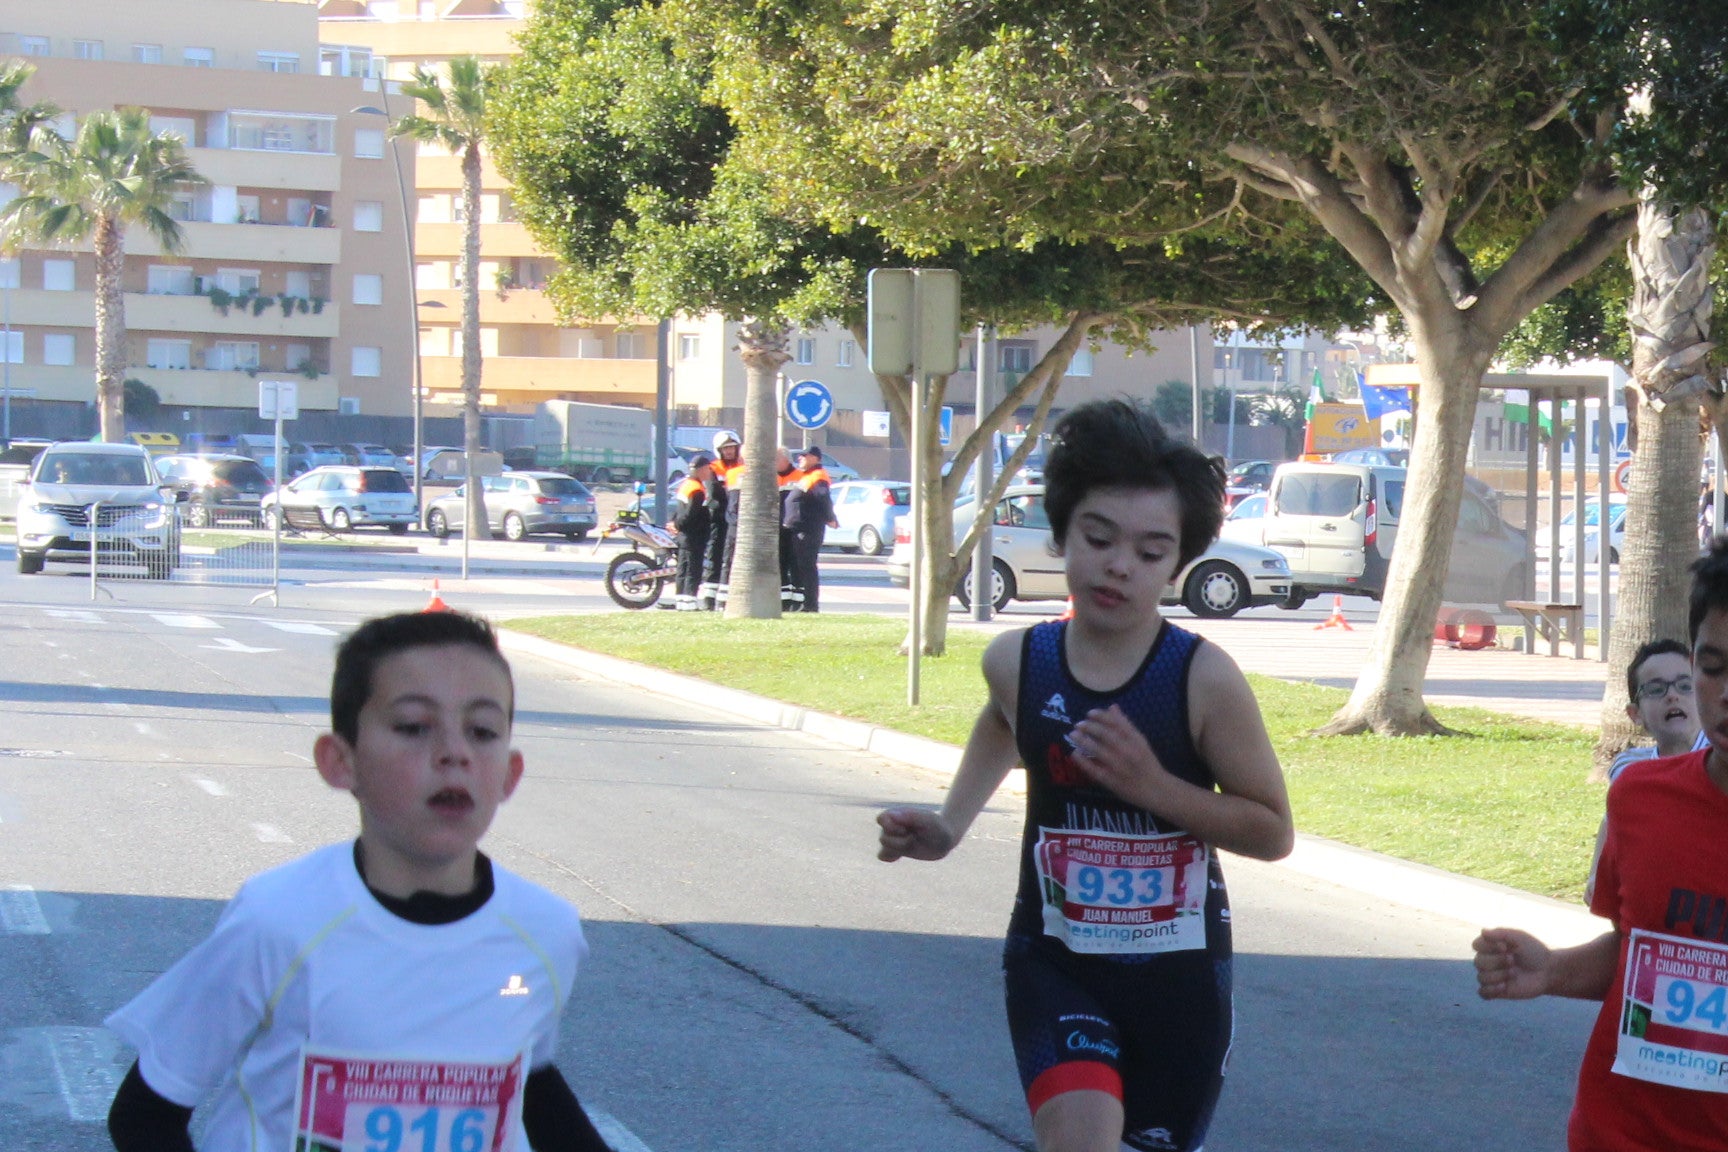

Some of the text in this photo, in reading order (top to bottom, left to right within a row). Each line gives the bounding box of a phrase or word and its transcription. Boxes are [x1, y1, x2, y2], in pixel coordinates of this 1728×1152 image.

[1084, 838, 1130, 852] CARRERA
[1133, 840, 1177, 853] POPULAR
[1067, 849, 1173, 866] CIUDAD DE ROQUETAS
[1078, 866, 1163, 905] 933
[1082, 909, 1153, 923] JUAN MANUEL
[1067, 922, 1179, 941] eetingpoint
[1658, 943, 1674, 957] VIII
[1677, 945, 1727, 967] CARRERA
[1655, 958, 1694, 977] CIUDAD
[1698, 966, 1711, 980] DE
[346, 1062, 507, 1083] VIII CARRERA POPULAR
[344, 1083, 499, 1103] CIUDAD DE ROQUETAS
